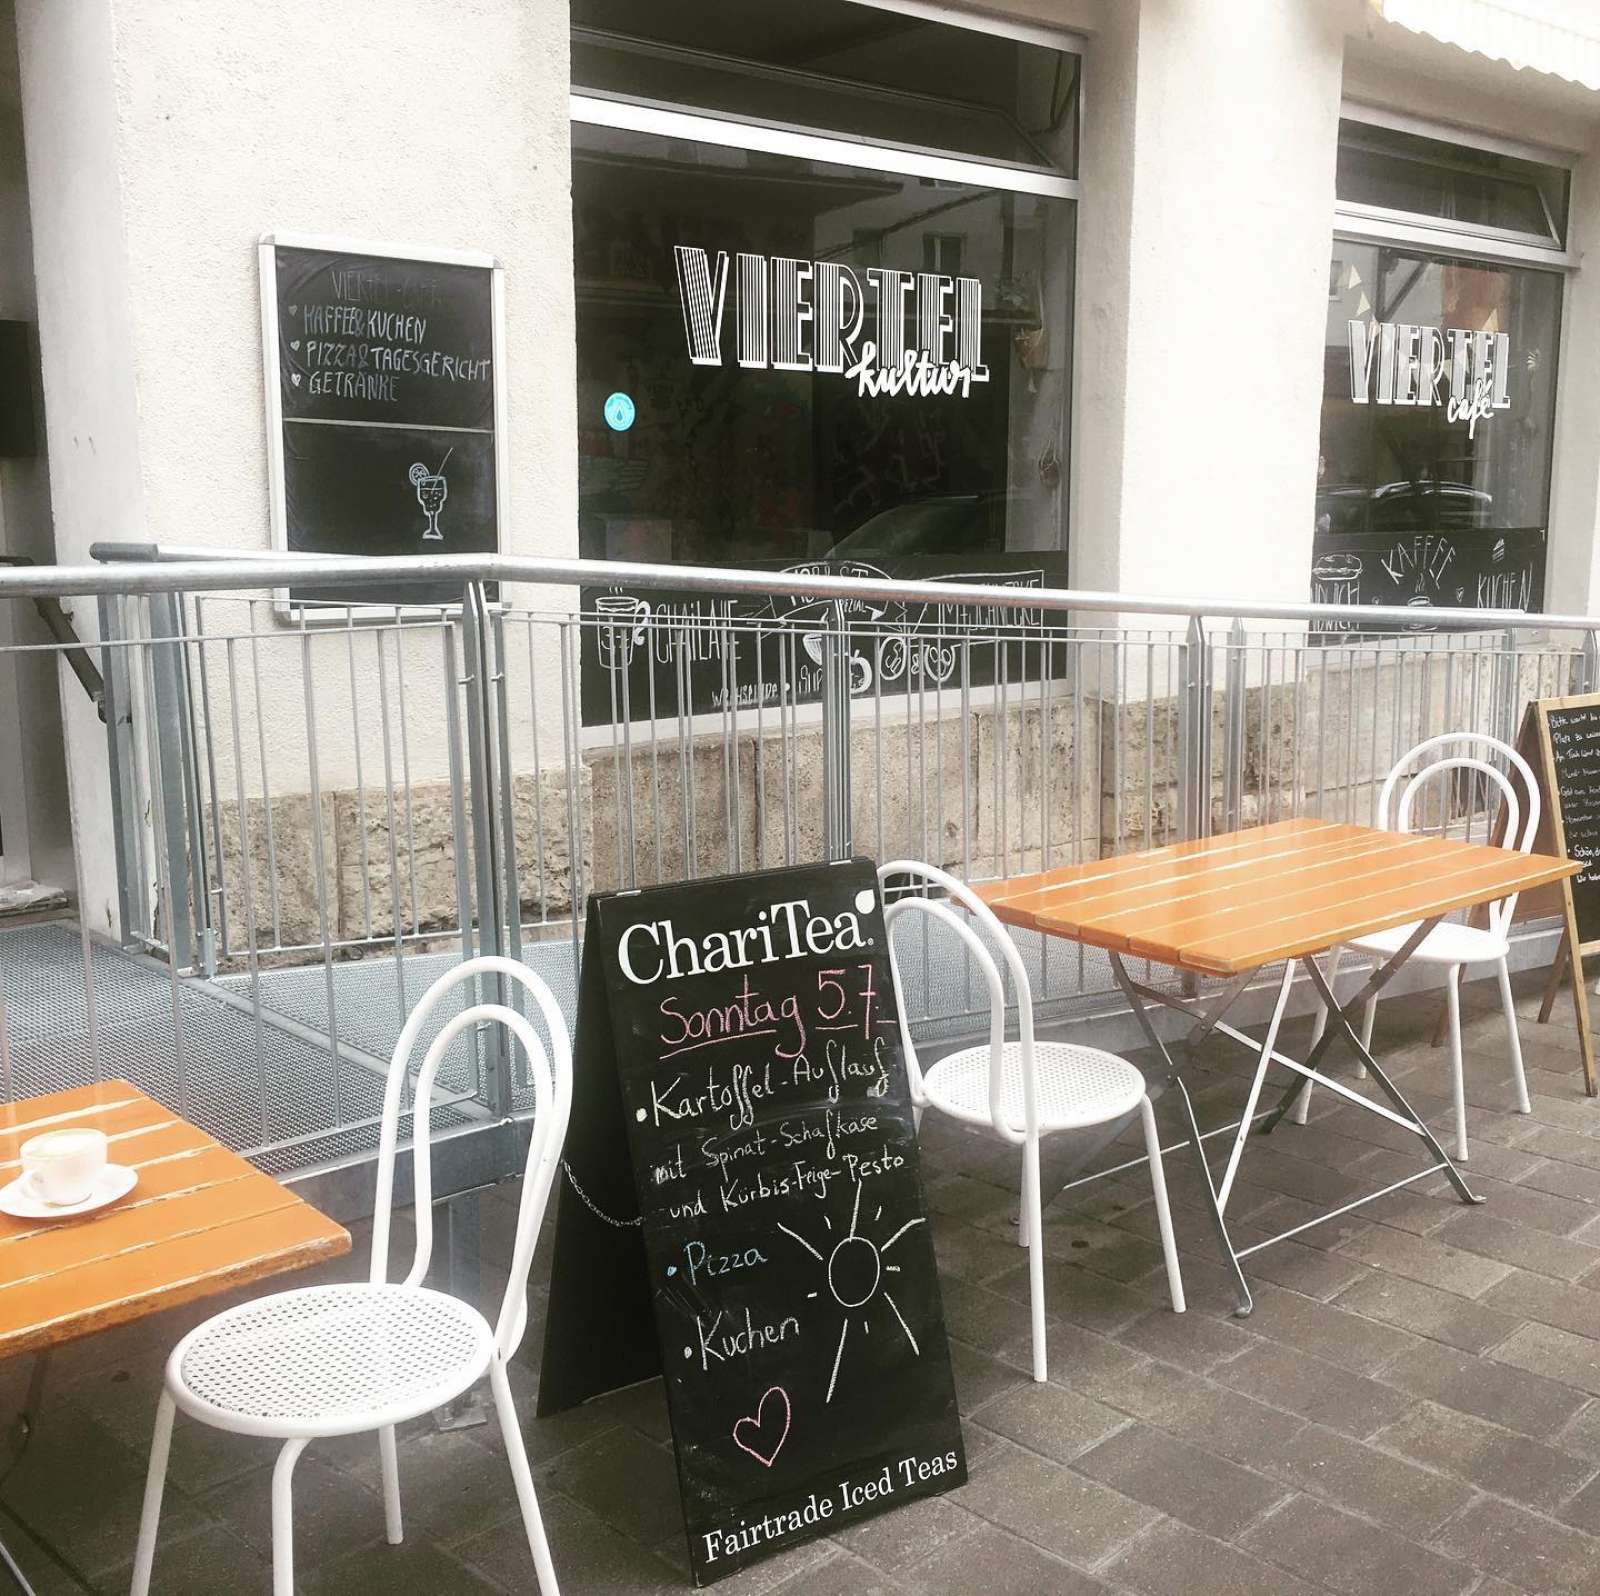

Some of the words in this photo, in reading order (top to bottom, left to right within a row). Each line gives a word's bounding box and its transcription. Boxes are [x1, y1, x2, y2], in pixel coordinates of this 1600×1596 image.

[674, 246, 990, 382] VIERTEL
[845, 341, 972, 398] kultur
[1348, 320, 1511, 409] VIERTEL
[1446, 378, 1495, 439] café
[618, 899, 868, 985] ChariTea
[660, 974, 807, 1059] Sonntag
[654, 1143, 687, 1185] mit
[669, 1189, 708, 1219] und
[684, 1240, 769, 1287] Pizza
[696, 1306, 801, 1371] Kuchen
[701, 1494, 834, 1564] Fairtrade
[838, 1467, 895, 1512] Iced
[898, 1450, 959, 1488] Teas
